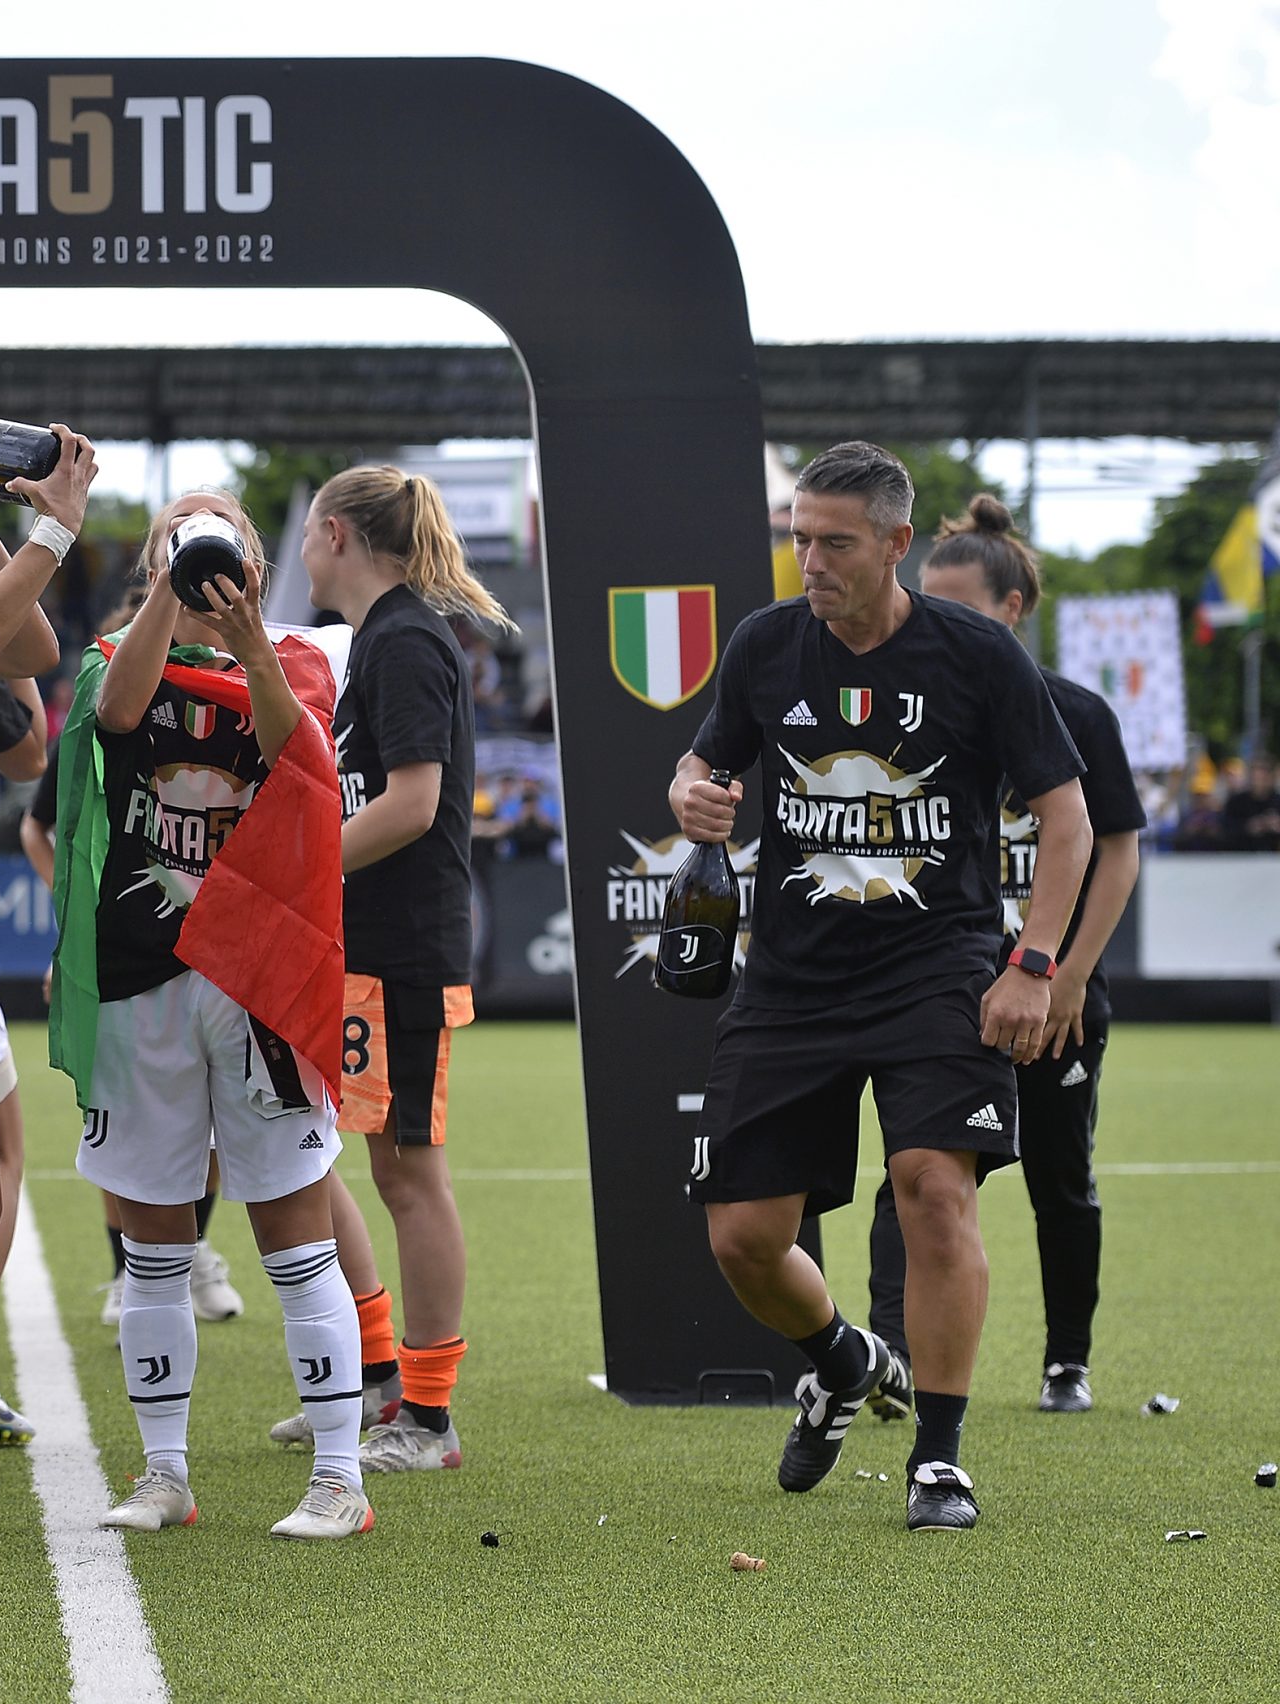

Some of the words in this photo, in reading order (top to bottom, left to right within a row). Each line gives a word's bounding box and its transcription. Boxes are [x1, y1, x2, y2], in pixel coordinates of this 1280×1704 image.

[92, 235, 274, 264] 2021-2022
[782, 716, 818, 726] adidas
[966, 1117, 1003, 1132] adidas
